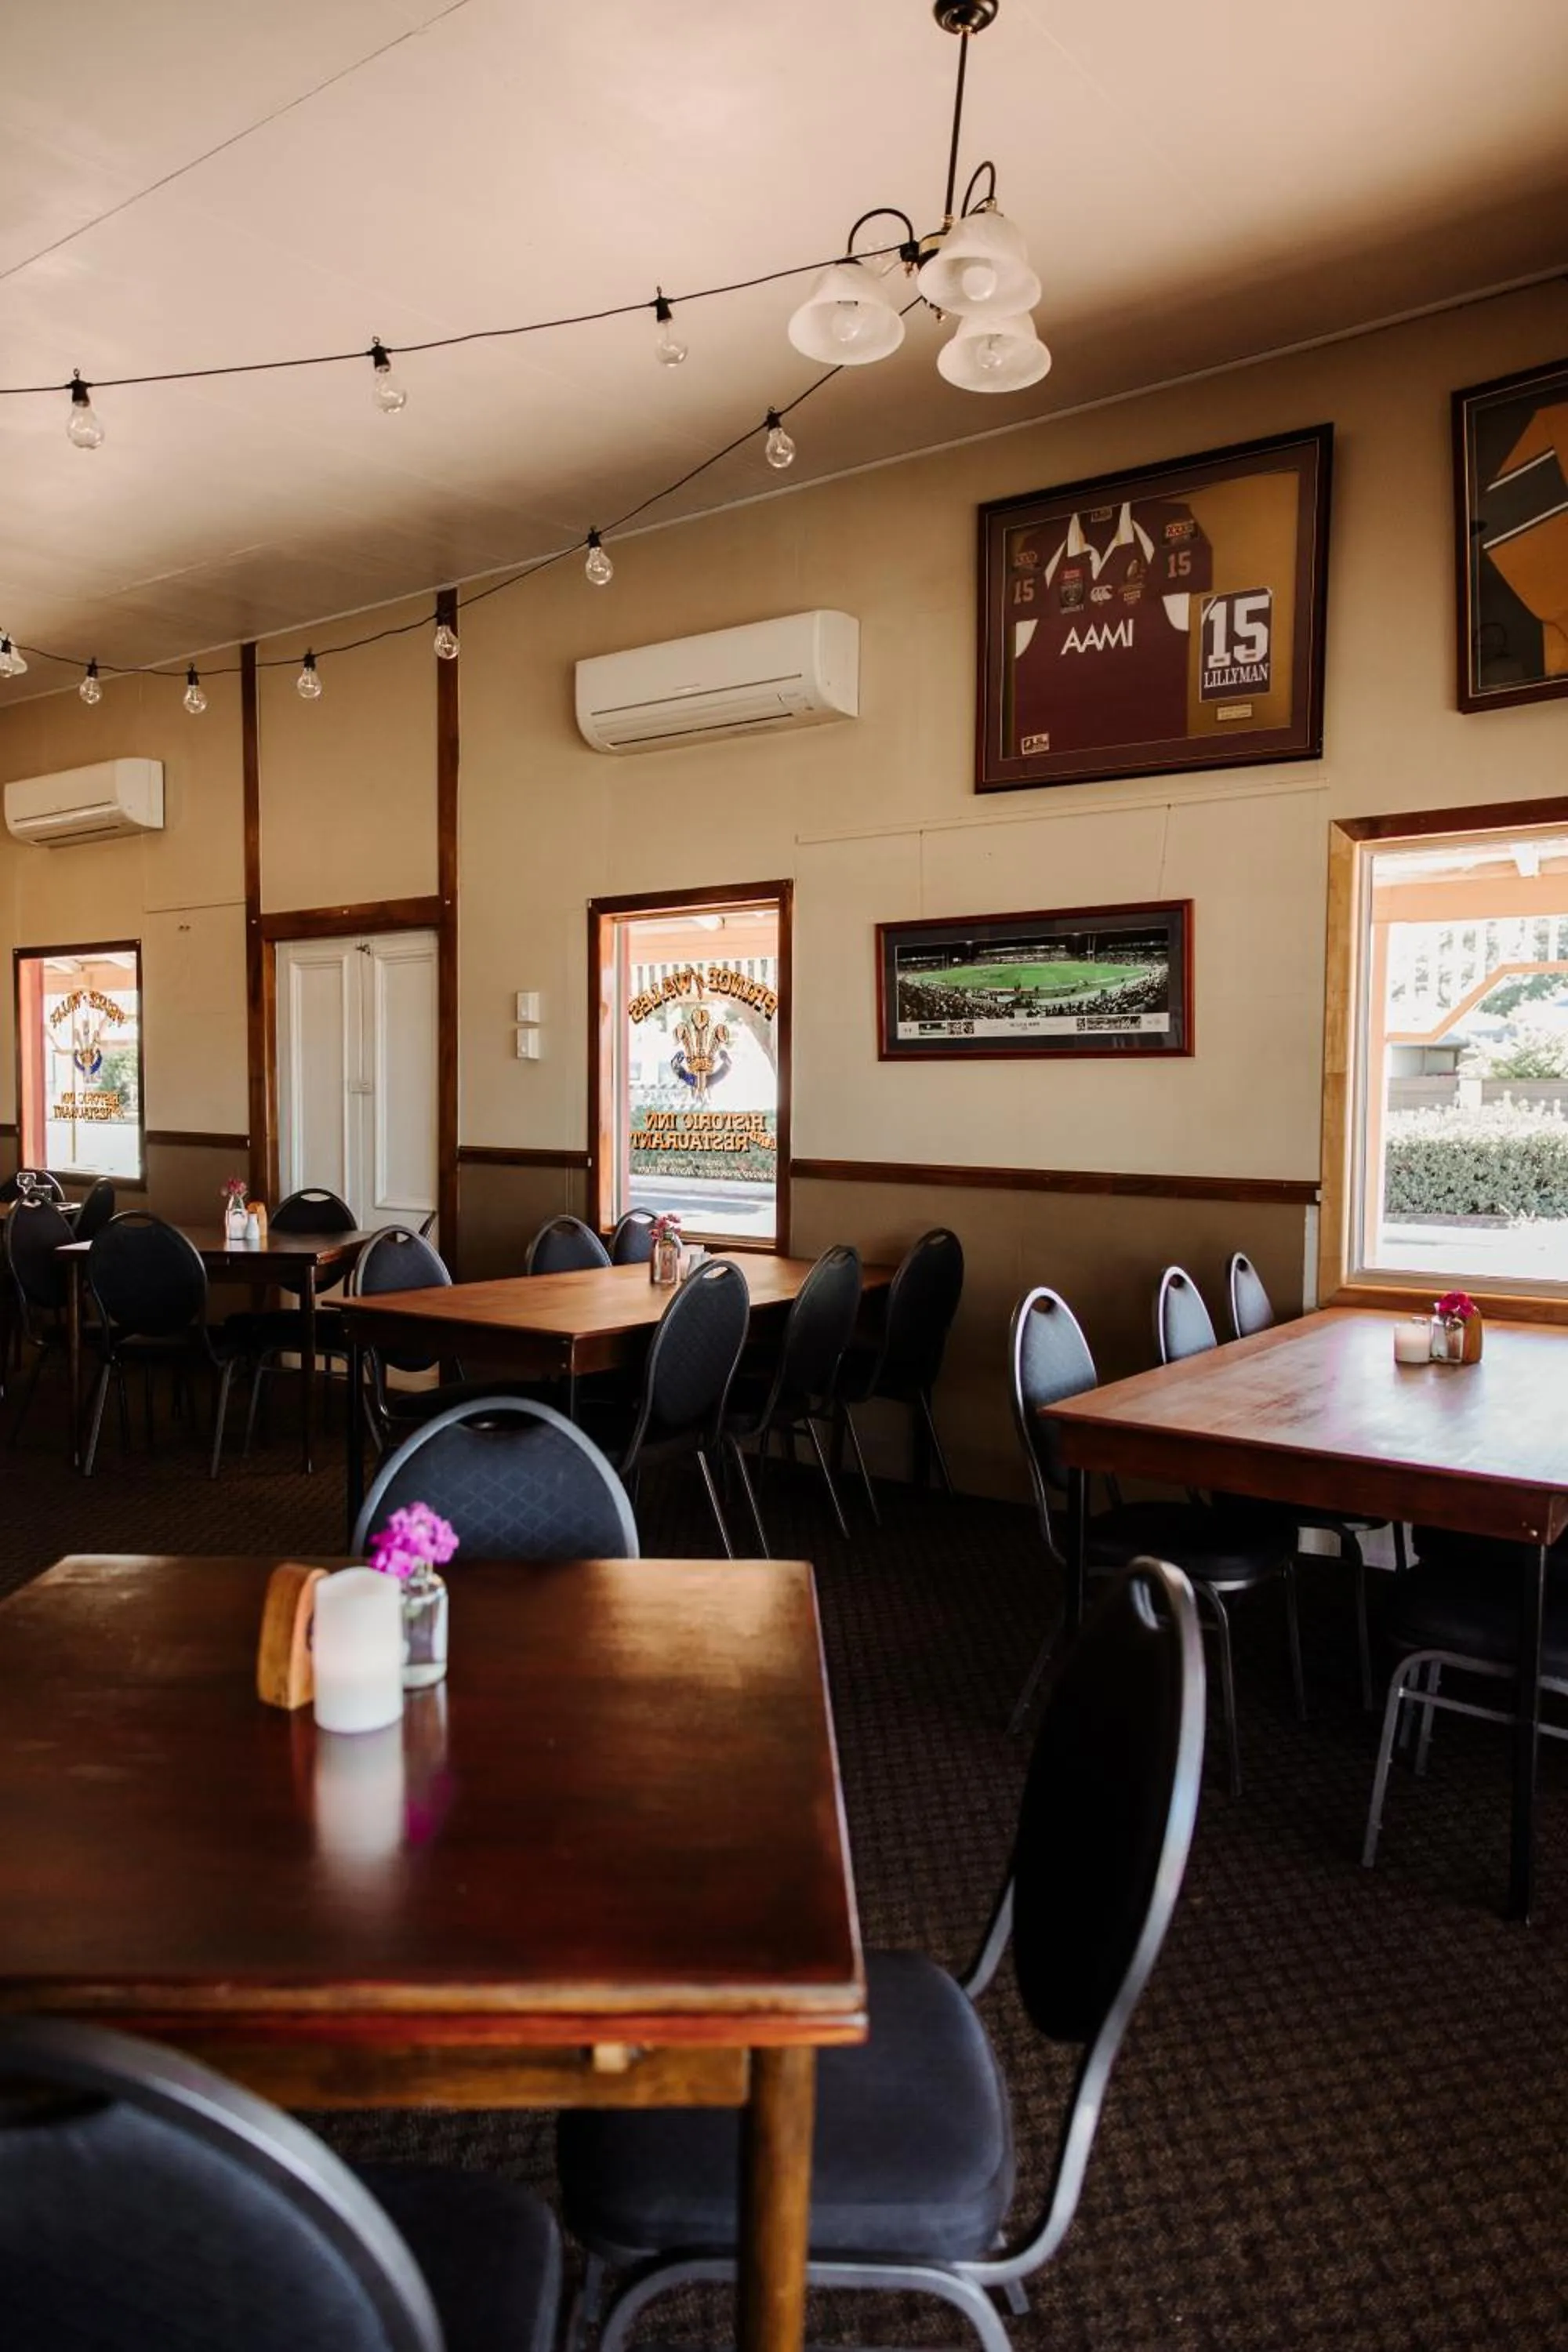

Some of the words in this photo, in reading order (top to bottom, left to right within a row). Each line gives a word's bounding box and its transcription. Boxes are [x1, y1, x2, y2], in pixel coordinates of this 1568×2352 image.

[1167, 550, 1192, 578] 15
[1014, 579, 1035, 604] 15
[1060, 619, 1134, 655] AAMI
[1208, 594, 1270, 669] 15
[1203, 662, 1269, 688] LILLYMAN
